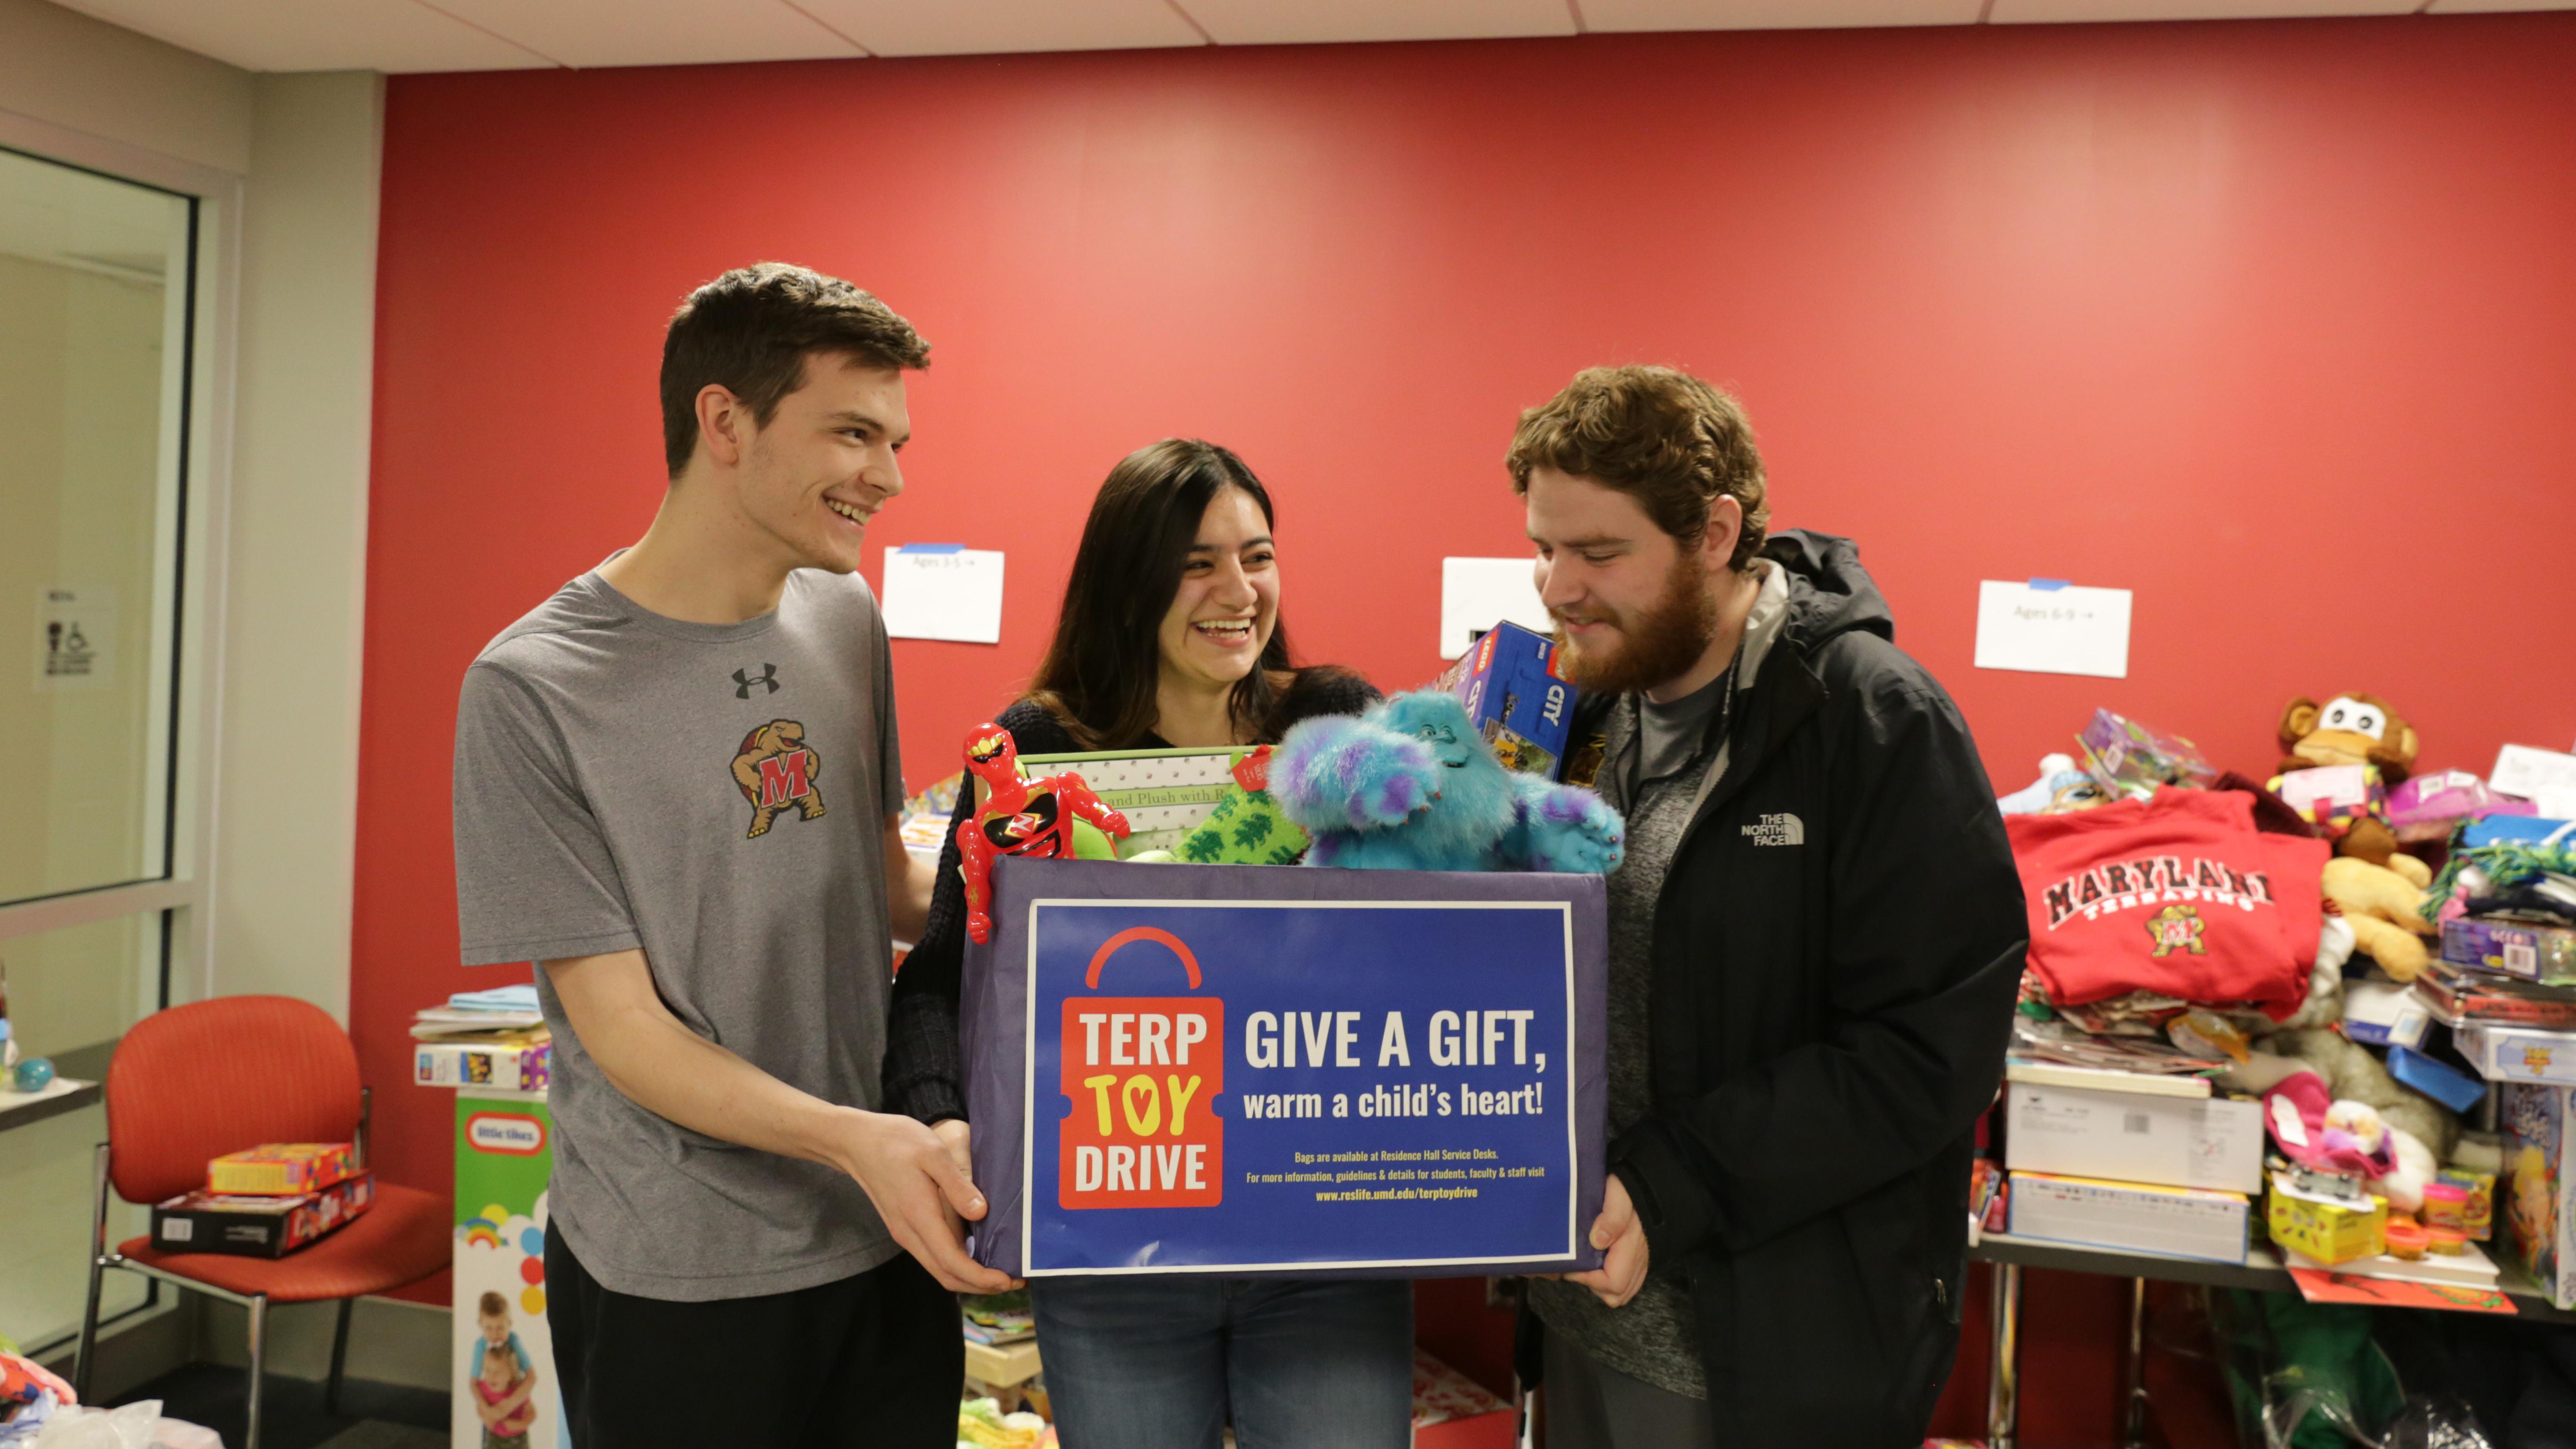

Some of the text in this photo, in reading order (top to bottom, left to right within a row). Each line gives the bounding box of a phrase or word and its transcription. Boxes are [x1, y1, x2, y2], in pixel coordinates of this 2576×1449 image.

[2014, 605, 2046, 620] Ages
[1478, 637, 1492, 670] LEGO
[1543, 684, 1565, 727] CITY
[759, 749, 810, 809] M
[1108, 793, 1133, 806] and
[1137, 791, 1176, 805] Plush
[1180, 789, 1210, 802] with
[1741, 824, 1784, 836] NORTH
[1759, 813, 1783, 825] THE
[1754, 835, 1785, 846] FACE
[1079, 1014, 1207, 1065] TERP
[1245, 1010, 1546, 1073] GIVE A GIFT,
[1084, 1074, 1201, 1136] TOY
[1243, 1082, 1543, 1119] warm a child's heart!
[1076, 1144, 1206, 1191] DRIVE
[1295, 1149, 1498, 1164] Bags are available at Residence Hall Service Desks.
[1247, 1167, 1545, 1183] For more information, guidelines & details for students, faculty & staff visit
[1316, 1186, 1478, 1201] www.reslife.umd.edu/terptoydrive
